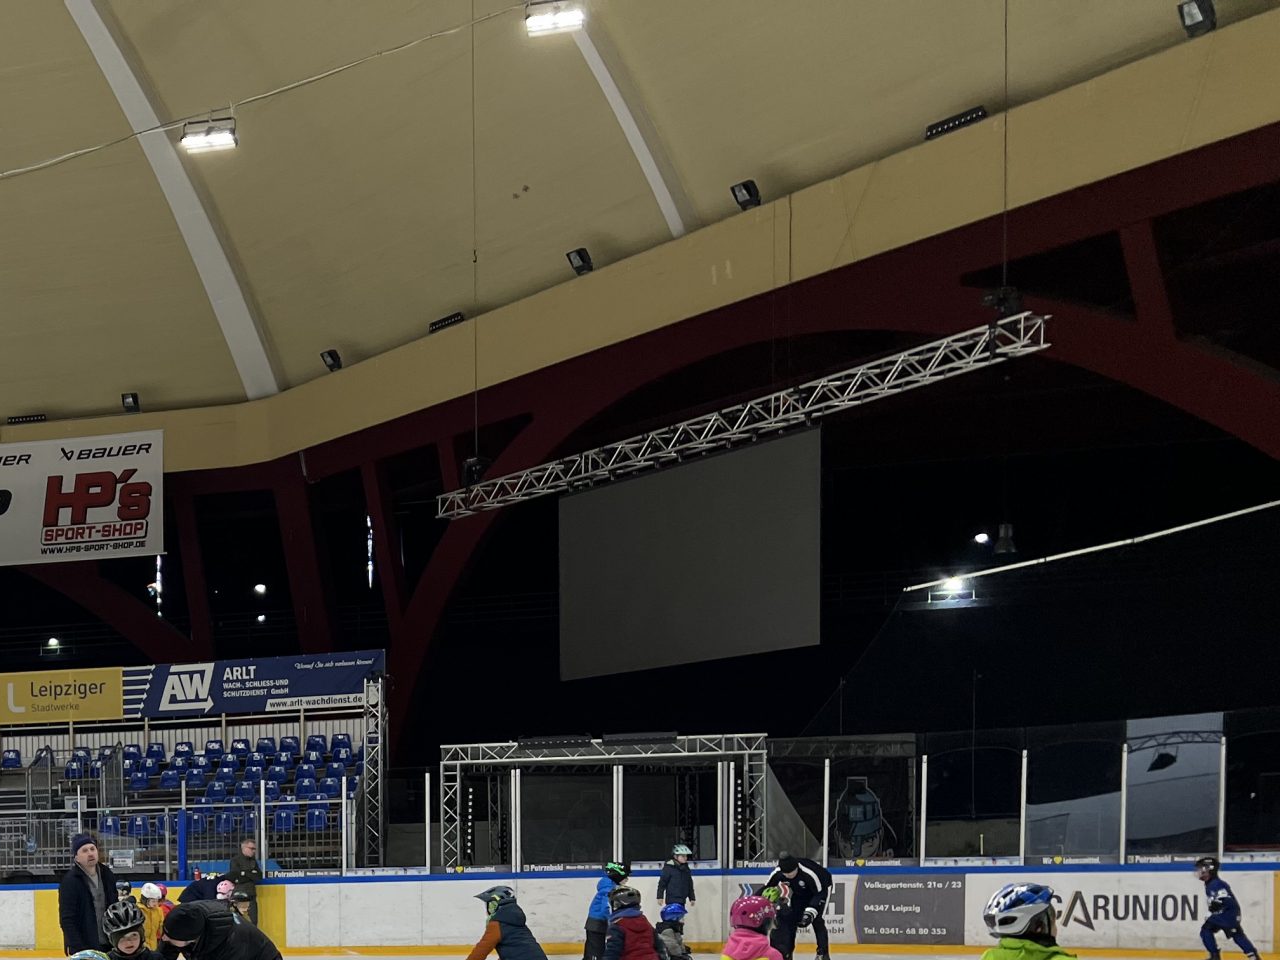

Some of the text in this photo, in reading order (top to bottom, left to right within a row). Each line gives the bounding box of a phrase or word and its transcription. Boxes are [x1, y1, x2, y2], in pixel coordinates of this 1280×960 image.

[77, 443, 152, 460] BAUER
[44, 521, 145, 542] SPORT-SHOP
[223, 666, 256, 681] ARLT
[30, 680, 106, 700] Leipziger
[160, 664, 214, 706] AW
[223, 687, 289, 698] SCHUTZDIENST GmbH
[32, 702, 80, 713] Stadtwerke
[269, 695, 363, 708] www.arlt-wachdienst.de
[864, 881, 925, 890] Volksgartenstr.
[927, 881, 943, 889] 21a
[951, 881, 962, 889] 23
[864, 904, 921, 913] 04347 Leipzig
[905, 928, 916, 936] 68
[918, 928, 929, 936] 80
[930, 927, 947, 936] 353
